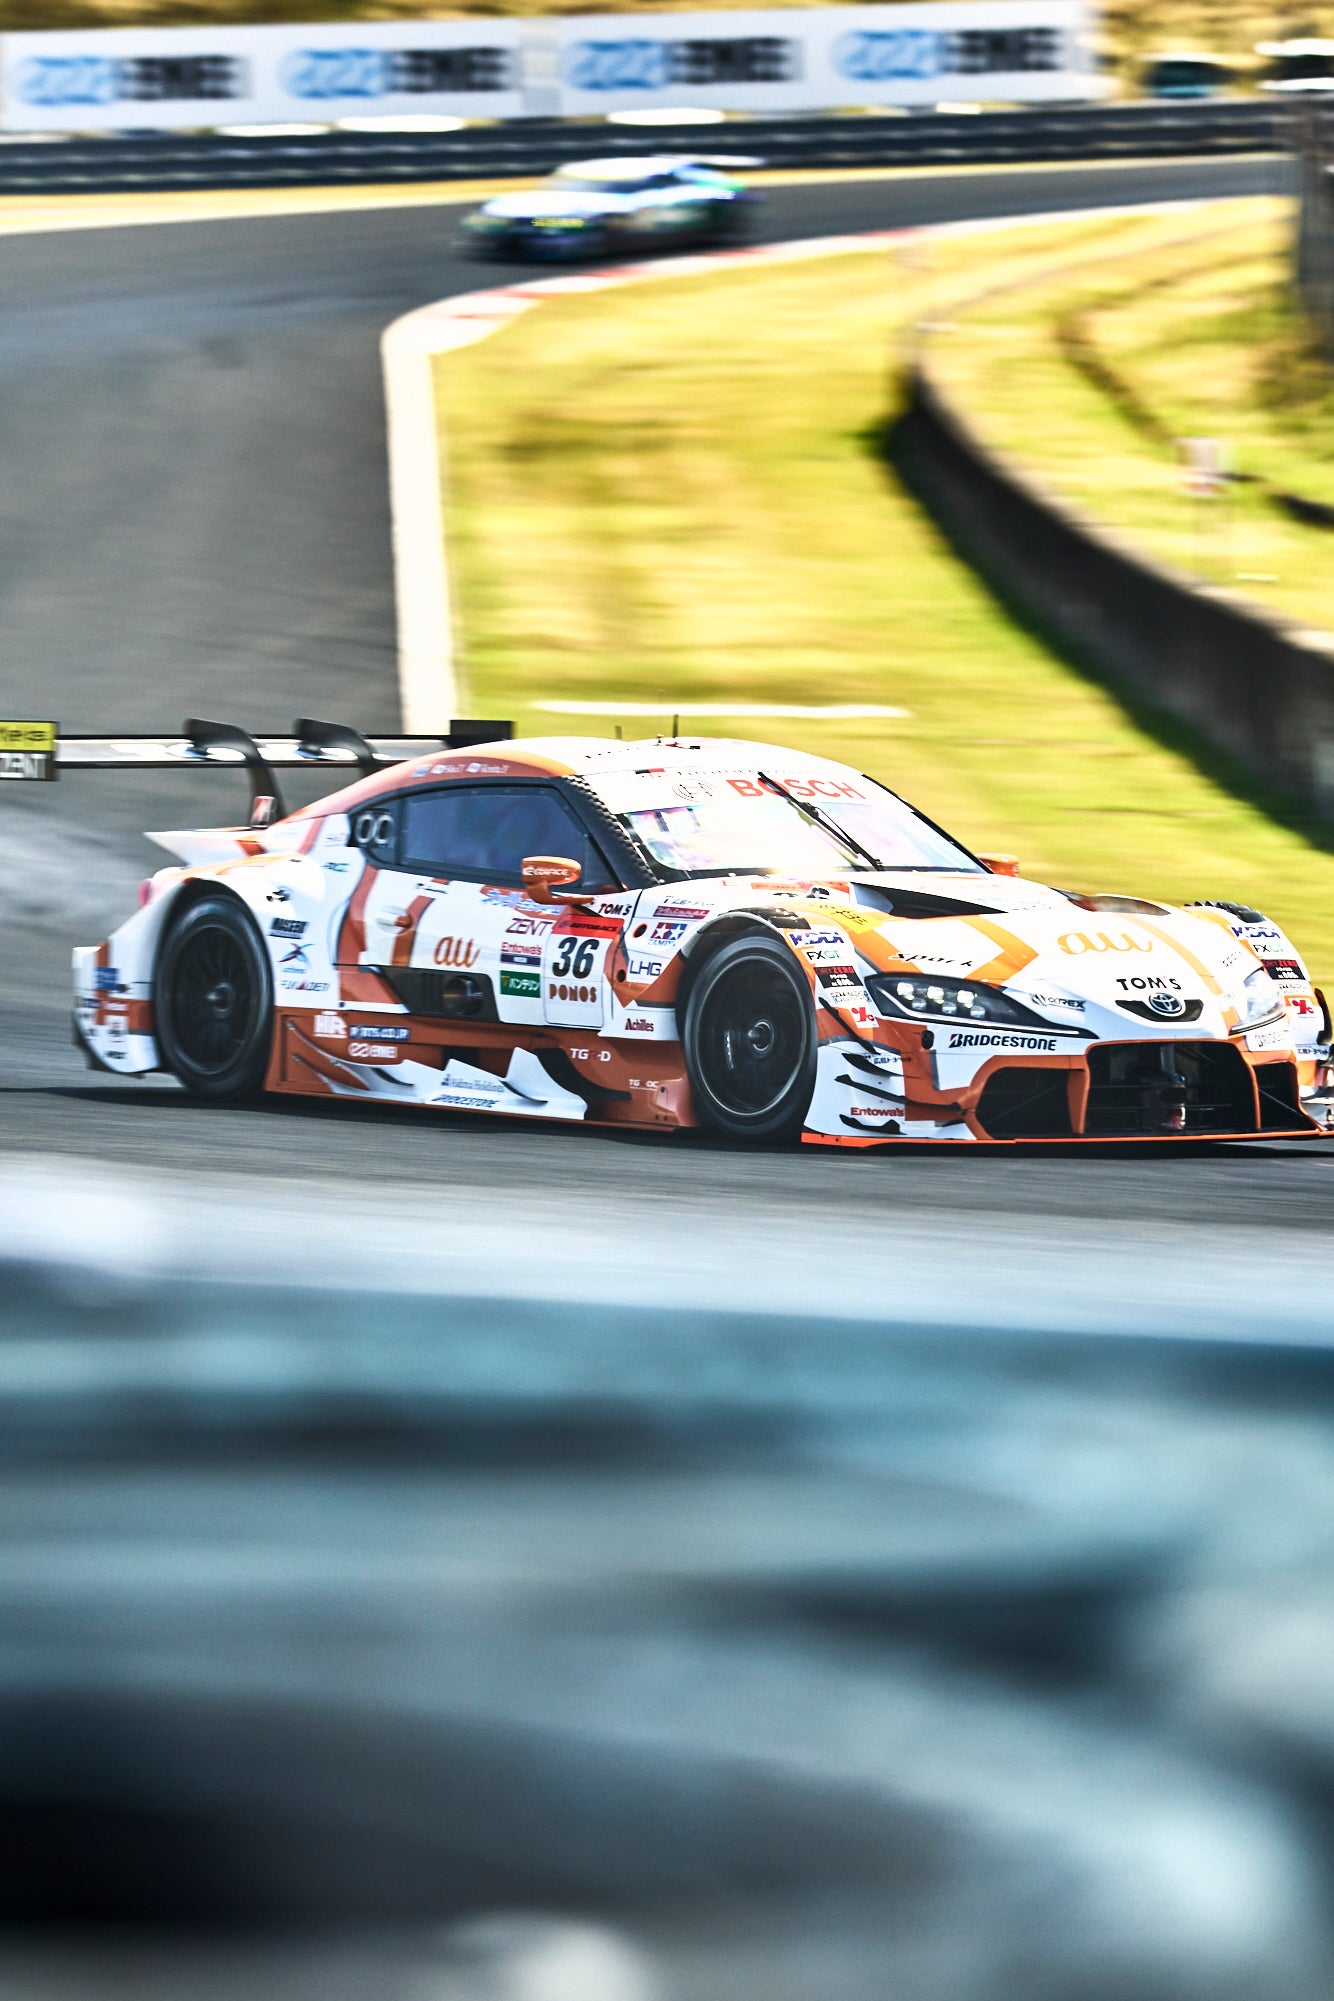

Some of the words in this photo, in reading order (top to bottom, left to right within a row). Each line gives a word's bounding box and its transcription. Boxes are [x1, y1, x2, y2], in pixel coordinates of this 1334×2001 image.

[726, 779, 866, 799] BOSCH
[505, 917, 553, 936] ZENT
[1231, 926, 1281, 939] KDDI
[789, 932, 845, 946] KDDI
[1056, 932, 1153, 955] au
[433, 936, 480, 968] au
[552, 936, 600, 979] 36
[629, 960, 662, 976] LHG
[1116, 975, 1182, 991] TOM'S
[549, 983, 598, 1003] PONOS
[625, 1018, 655, 1032] Achilles
[948, 1033, 1057, 1051] BRIDGESTONE
